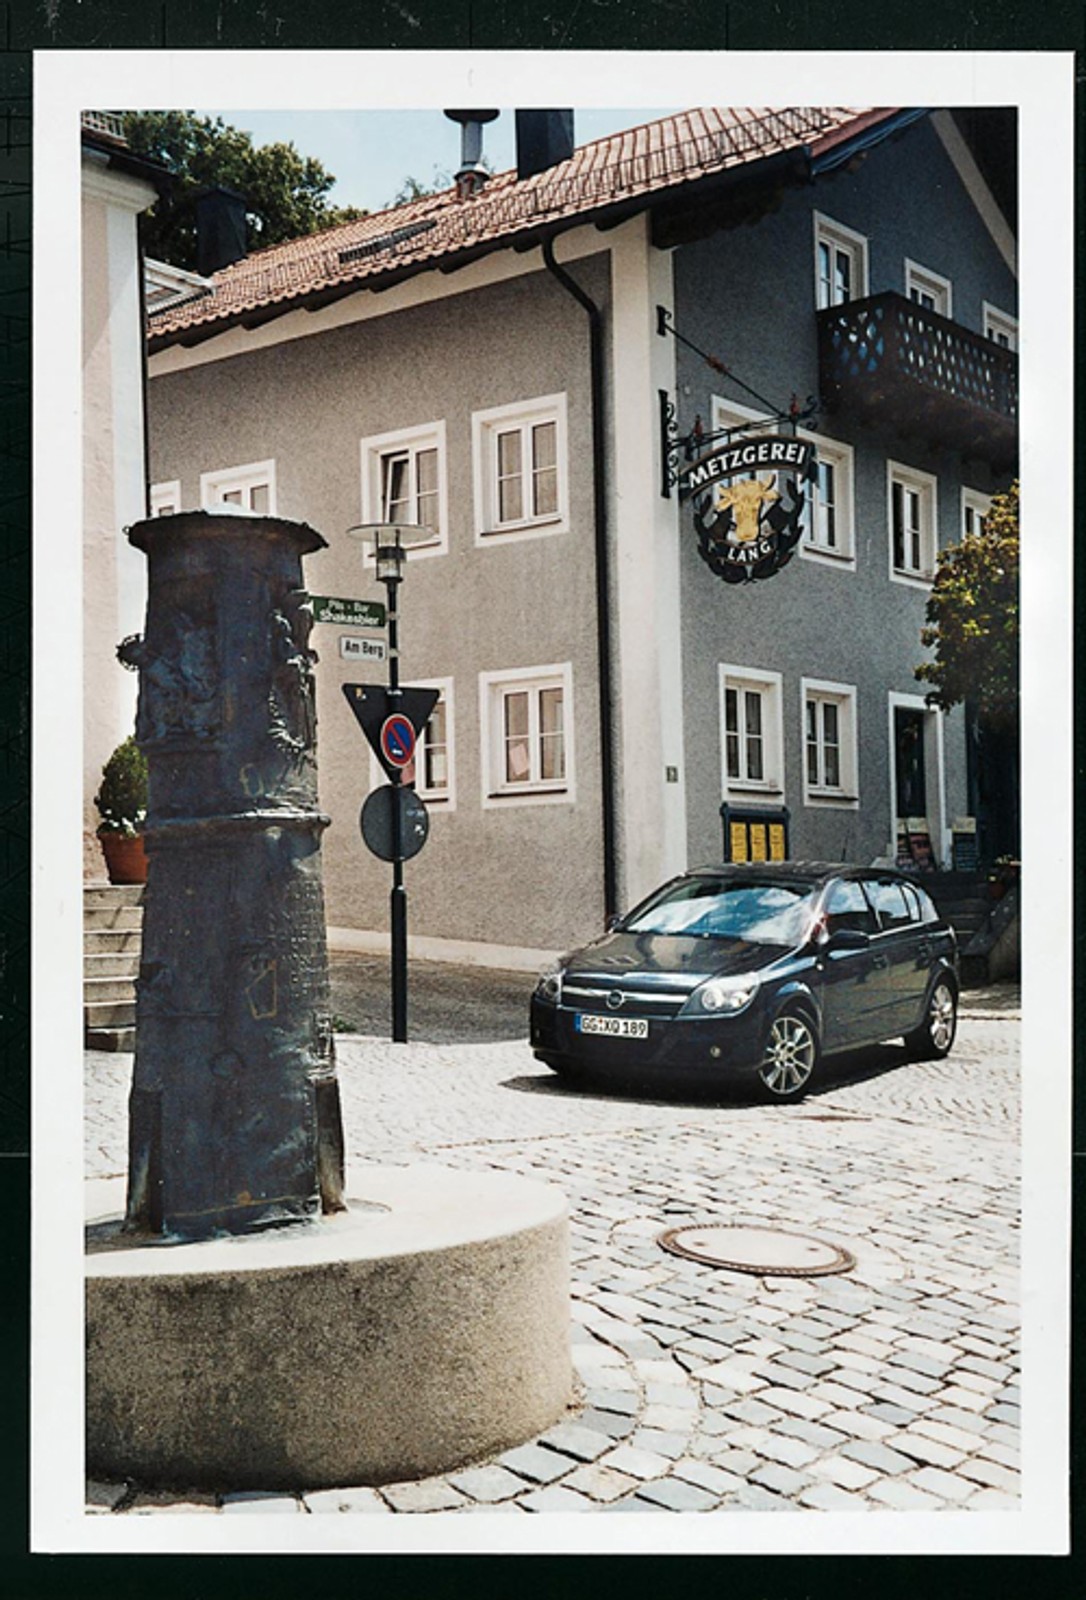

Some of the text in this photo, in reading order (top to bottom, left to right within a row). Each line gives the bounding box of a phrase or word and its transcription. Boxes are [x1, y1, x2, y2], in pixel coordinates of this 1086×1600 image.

[688, 442, 806, 489] METZGEREI
[727, 540, 771, 563] LANG
[345, 640, 384, 659] Am Berg
[622, 1020, 647, 1036] 189
